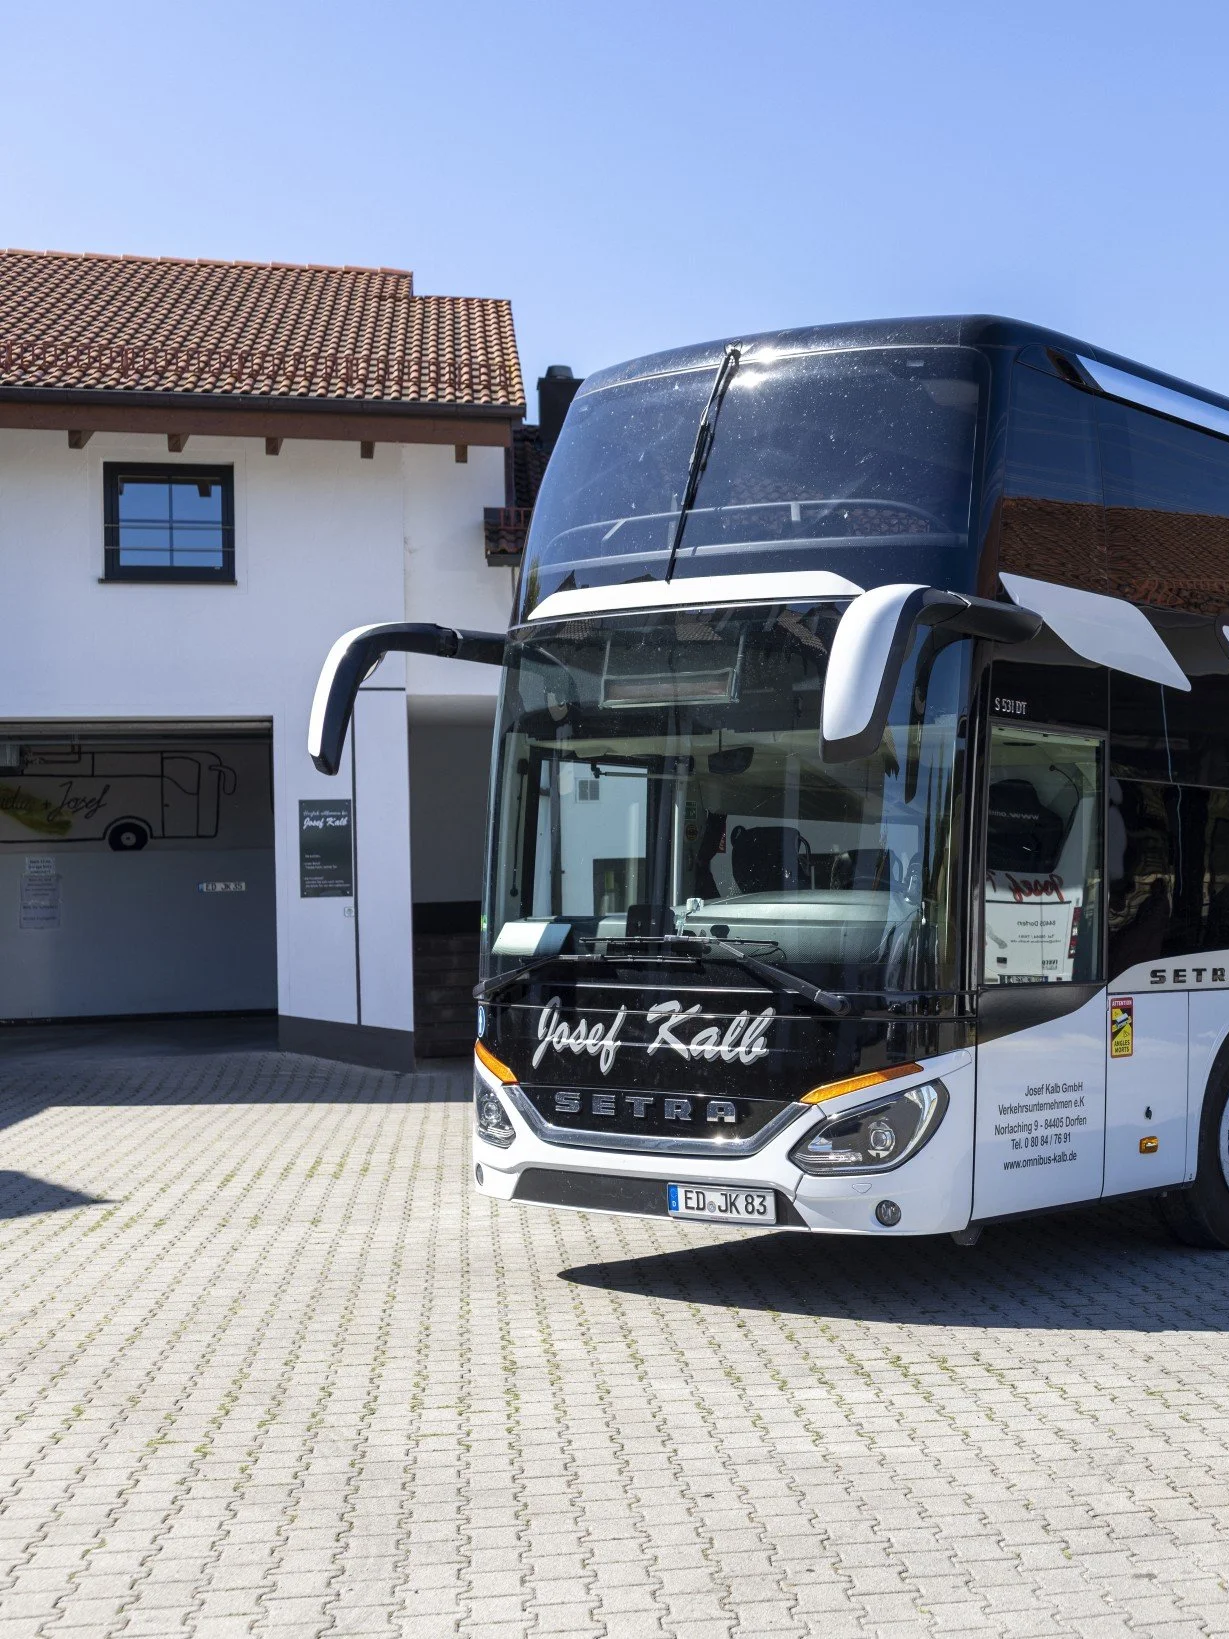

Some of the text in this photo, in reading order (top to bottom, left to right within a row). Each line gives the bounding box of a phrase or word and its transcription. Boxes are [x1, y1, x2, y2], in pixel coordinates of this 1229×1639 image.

[995, 697, 1027, 715] S 531 DT
[47, 780, 111, 823] Josef
[303, 816, 348, 830] Josef Kalb
[1112, 999, 1132, 1007] ATTENTION
[532, 996, 777, 1076] Josef Kalb
[1113, 1039, 1130, 1047] ANGLES
[1025, 1081, 1084, 1097] Josef Kalb GmbH
[554, 1091, 736, 1123] SETRA
[998, 1098, 1073, 1116] Verkehrsunternehmen
[994, 1121, 1033, 1136] Norlaching
[1034, 1119, 1039, 1131] 9
[1044, 1117, 1064, 1130] 84405
[1065, 1114, 1087, 1128] Dorfen
[1011, 1138, 1023, 1151] Tel.
[1024, 1137, 1029, 1149] 0
[1030, 1136, 1039, 1147] 80
[1040, 1135, 1049, 1147] 84
[1054, 1133, 1062, 1145] 76
[1063, 1132, 1071, 1144] 91
[1003, 1150, 1077, 1171] www.omnibus-kalb.de
[684, 1189, 767, 1216] ED JK 83
